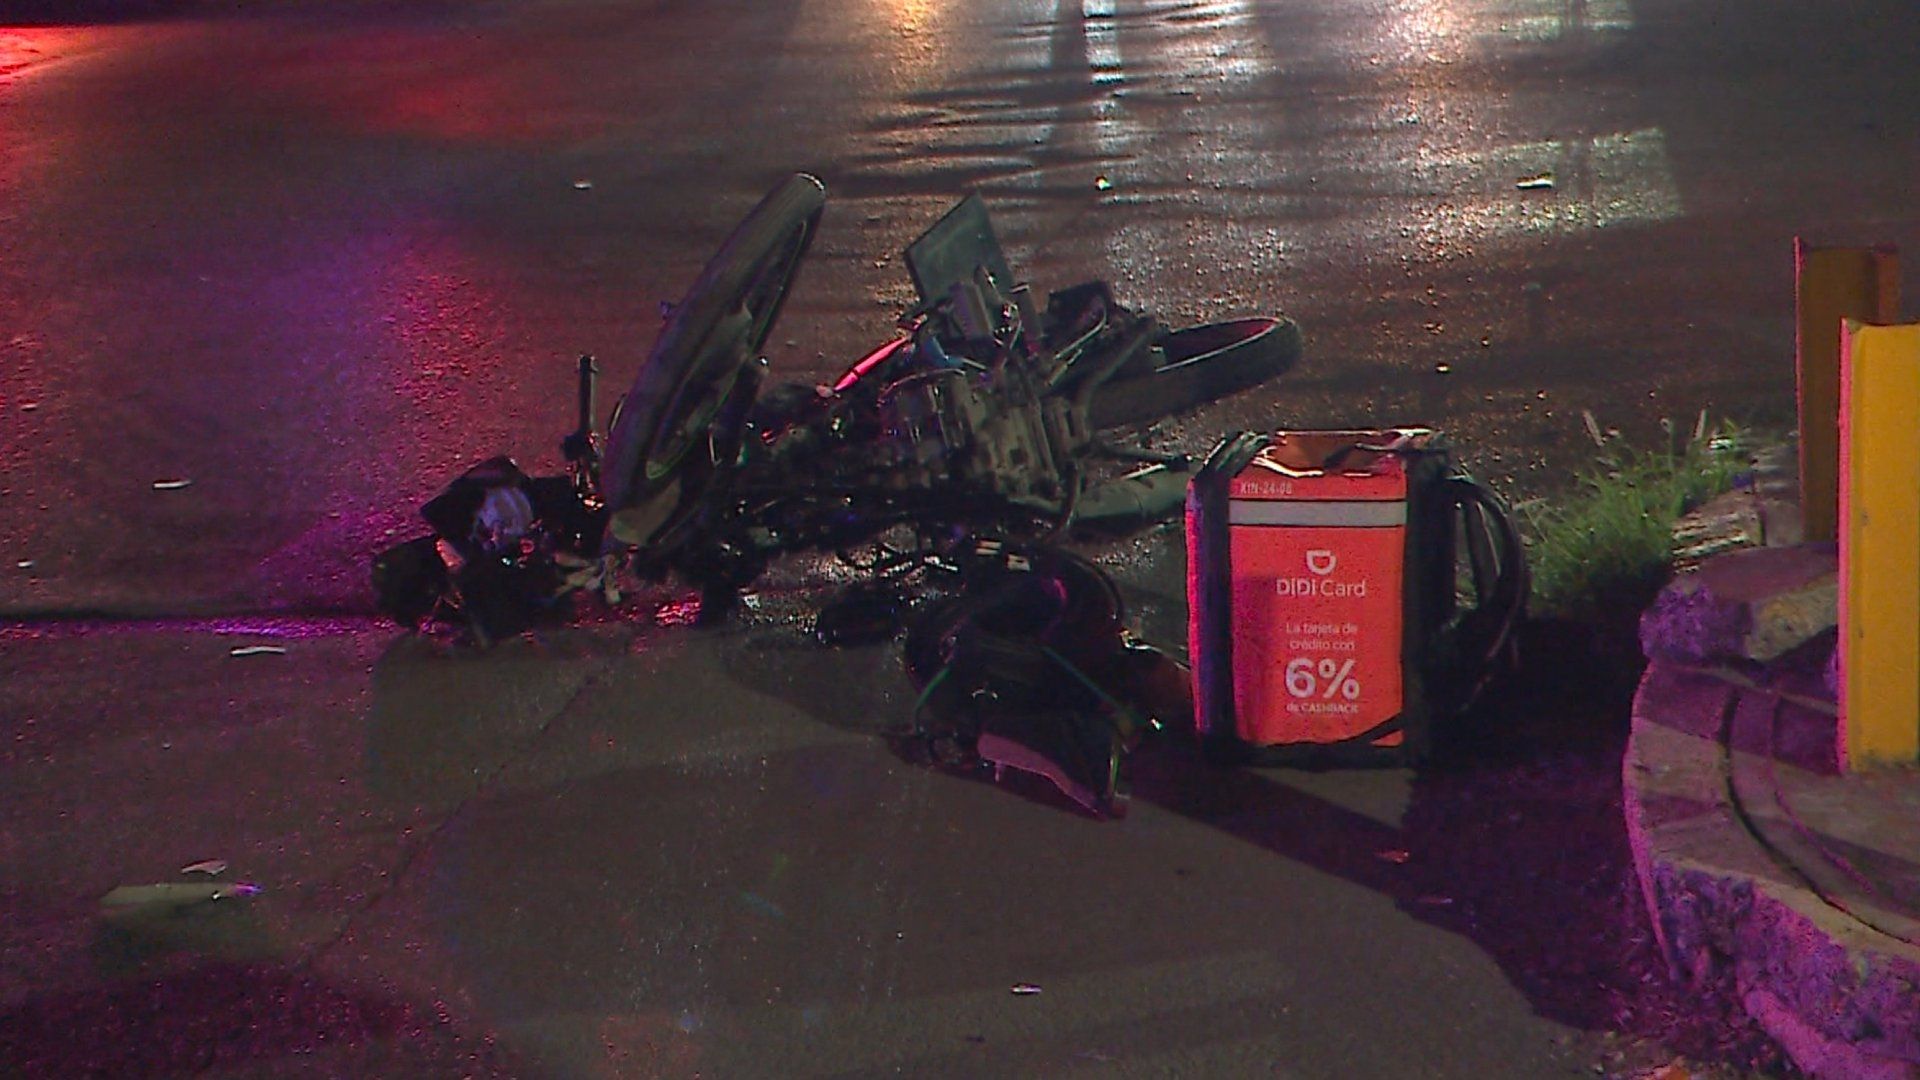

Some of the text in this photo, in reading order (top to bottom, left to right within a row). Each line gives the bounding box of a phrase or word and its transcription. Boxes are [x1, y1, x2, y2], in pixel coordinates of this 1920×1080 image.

[1321, 579, 1366, 597] Card
[1286, 622, 1358, 637] La tarjeta de
[1333, 640, 1355, 650] con
[1286, 658, 1360, 699] 6%
[1286, 703, 1299, 713] de
